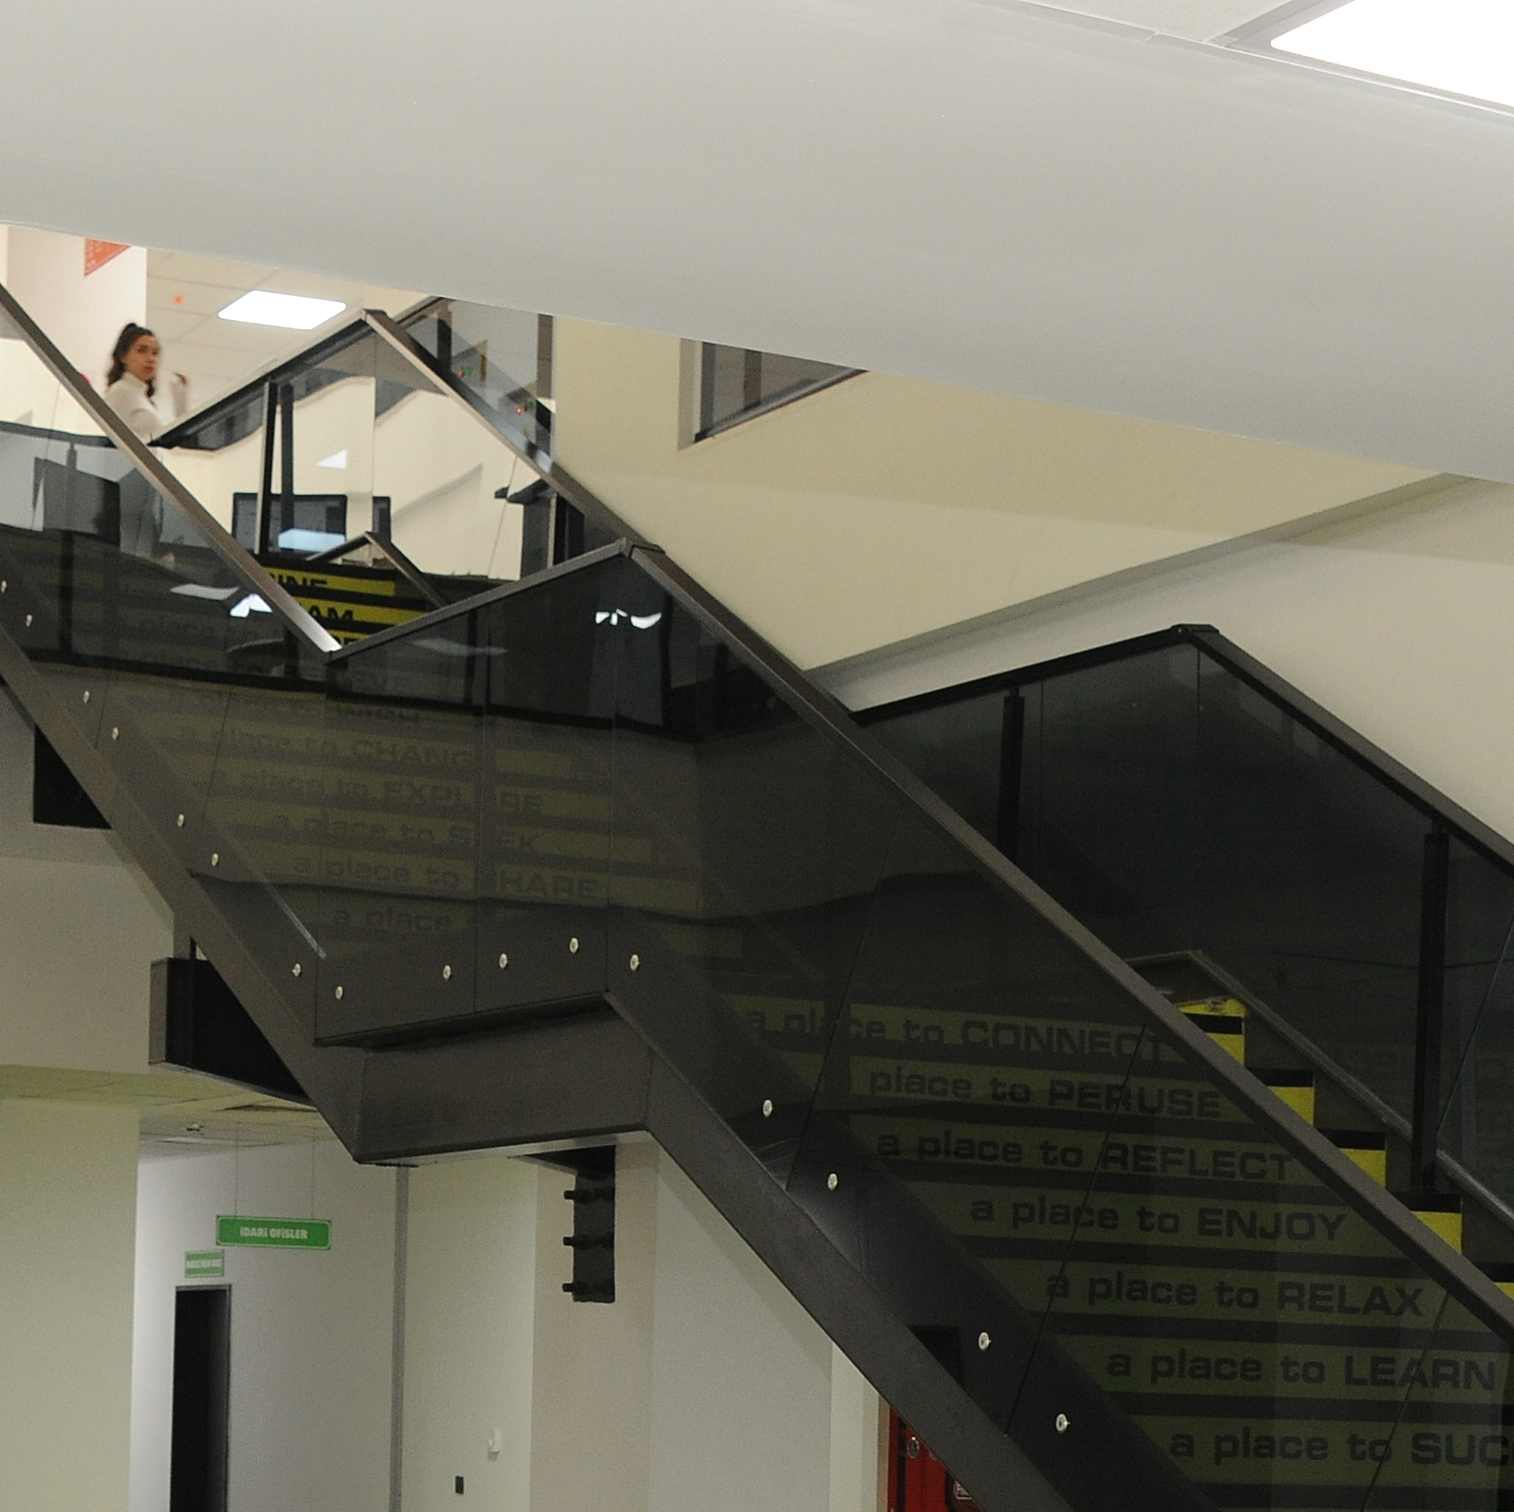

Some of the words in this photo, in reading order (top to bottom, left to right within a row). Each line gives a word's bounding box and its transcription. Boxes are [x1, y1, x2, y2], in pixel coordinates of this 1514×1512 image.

[351, 737, 475, 767] CHANG
[383, 779, 543, 816] EXPLRE
[399, 818, 434, 844] to
[448, 824, 537, 854] SEK
[327, 853, 410, 885] place
[427, 865, 460, 890] to
[496, 870, 600, 900] HARE
[367, 906, 451, 935] place
[905, 1018, 943, 1043] to
[961, 1019, 1168, 1059] CONNECT
[870, 1066, 972, 1097] place
[991, 1075, 1031, 1105] to
[1049, 1079, 1222, 1119] PERUSE
[877, 1132, 901, 1157] a
[917, 1130, 1024, 1164] place
[1041, 1139, 1083, 1167] to
[1101, 1141, 1296, 1183] REFLECT
[971, 1197, 995, 1222] a
[1012, 1195, 1120, 1232] place
[1137, 1206, 1179, 1234] to
[1197, 1208, 1346, 1242] ENJOY
[1045, 1274, 1070, 1298] a
[1088, 1271, 1198, 1308] place
[1215, 1280, 1259, 1310] to
[1278, 1281, 1424, 1318] RELAX
[1107, 1352, 1132, 1378] a
[1151, 1348, 1263, 1385] place
[1281, 1354, 1326, 1384] to
[1344, 1355, 1497, 1391] LEARN
[1169, 1432, 1195, 1458] a
[1214, 1426, 1329, 1465] place
[1349, 1432, 1393, 1463] to
